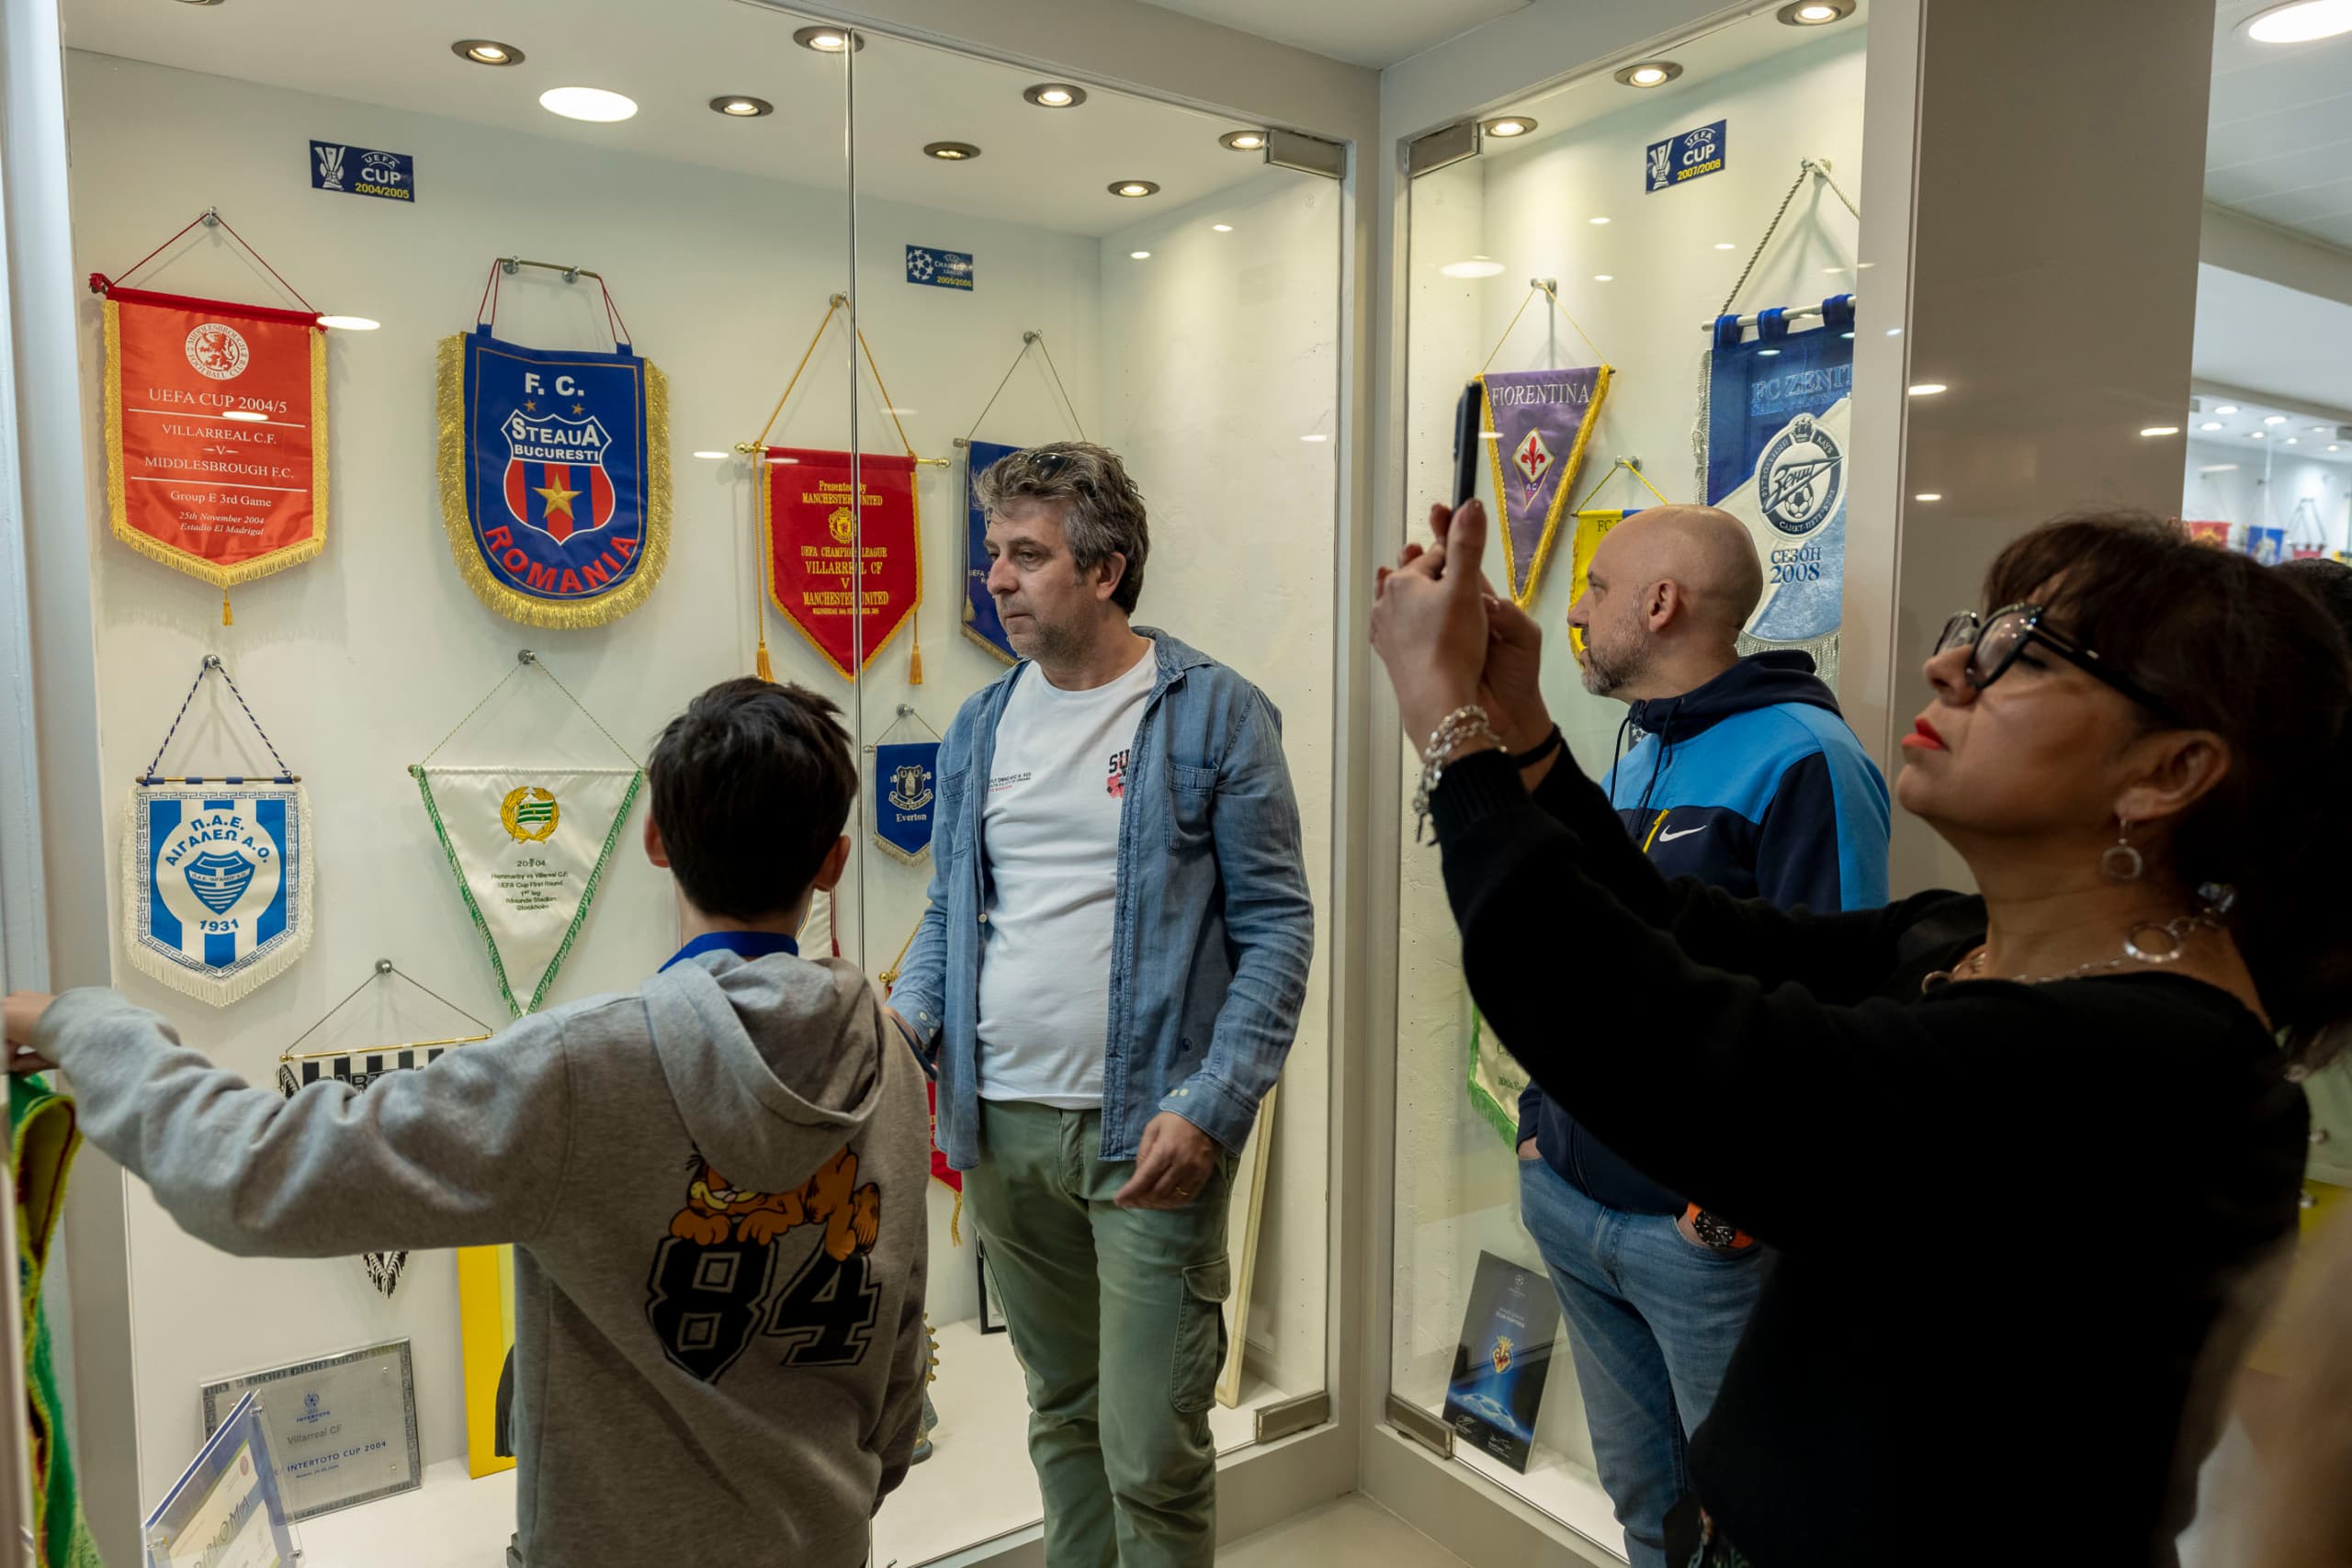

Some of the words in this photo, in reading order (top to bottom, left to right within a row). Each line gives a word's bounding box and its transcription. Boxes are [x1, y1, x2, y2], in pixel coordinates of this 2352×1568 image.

[1686, 130, 1713, 147] UEFA
[364, 154, 396, 167] UEFA
[1682, 143, 1715, 165] CUP
[361, 167, 401, 185] CUP
[1677, 159, 1721, 181] 2007/2008
[355, 183, 410, 199] 2004/2005
[525, 372, 545, 395] F.
[555, 375, 584, 396] C.
[1752, 378, 1781, 400] FC
[149, 388, 195, 404] UEFA
[198, 392, 234, 407] CUP
[238, 397, 288, 413] 2004/5
[1492, 383, 1591, 406] FIORENTINA
[162, 423, 251, 442] VILLARREAL
[254, 433, 277, 445] C.F.
[512, 417, 601, 447] STEAUA
[514, 444, 599, 461] BUCURESTI
[144, 457, 268, 477] MIDDLESBROUGH
[271, 468, 294, 479] F.C.
[170, 491, 205, 503] Group
[209, 493, 217, 502] E
[220, 493, 238, 504] 3rd
[240, 495, 272, 507] Game
[860, 494, 883, 506] NITED
[179, 511, 198, 521] 25th
[200, 513, 241, 524] November
[244, 515, 265, 525] 2004
[1597, 520, 1612, 532] FC
[180, 523, 211, 533] Estadio
[214, 525, 223, 533] El
[225, 525, 265, 536] Madrigal
[485, 525, 637, 592] ROMANIA
[801, 546, 818, 557] UEFA
[821, 547, 857, 558] CHAMPIO
[1770, 547, 1822, 565] СЕЗОН
[806, 560, 867, 575] VILLARREL
[870, 561, 883, 574] CF
[1770, 562, 1821, 584] 2008
[841, 577, 850, 589] V
[896, 813, 927, 822] Everton
[199, 919, 239, 931] 1931
[646, 1226, 883, 1385] 84
[287, 1427, 327, 1445] Villarreal
[287, 1453, 340, 1472] INTERTOTO
[343, 1447, 361, 1458] CUP
[365, 1440, 386, 1451] 2004
